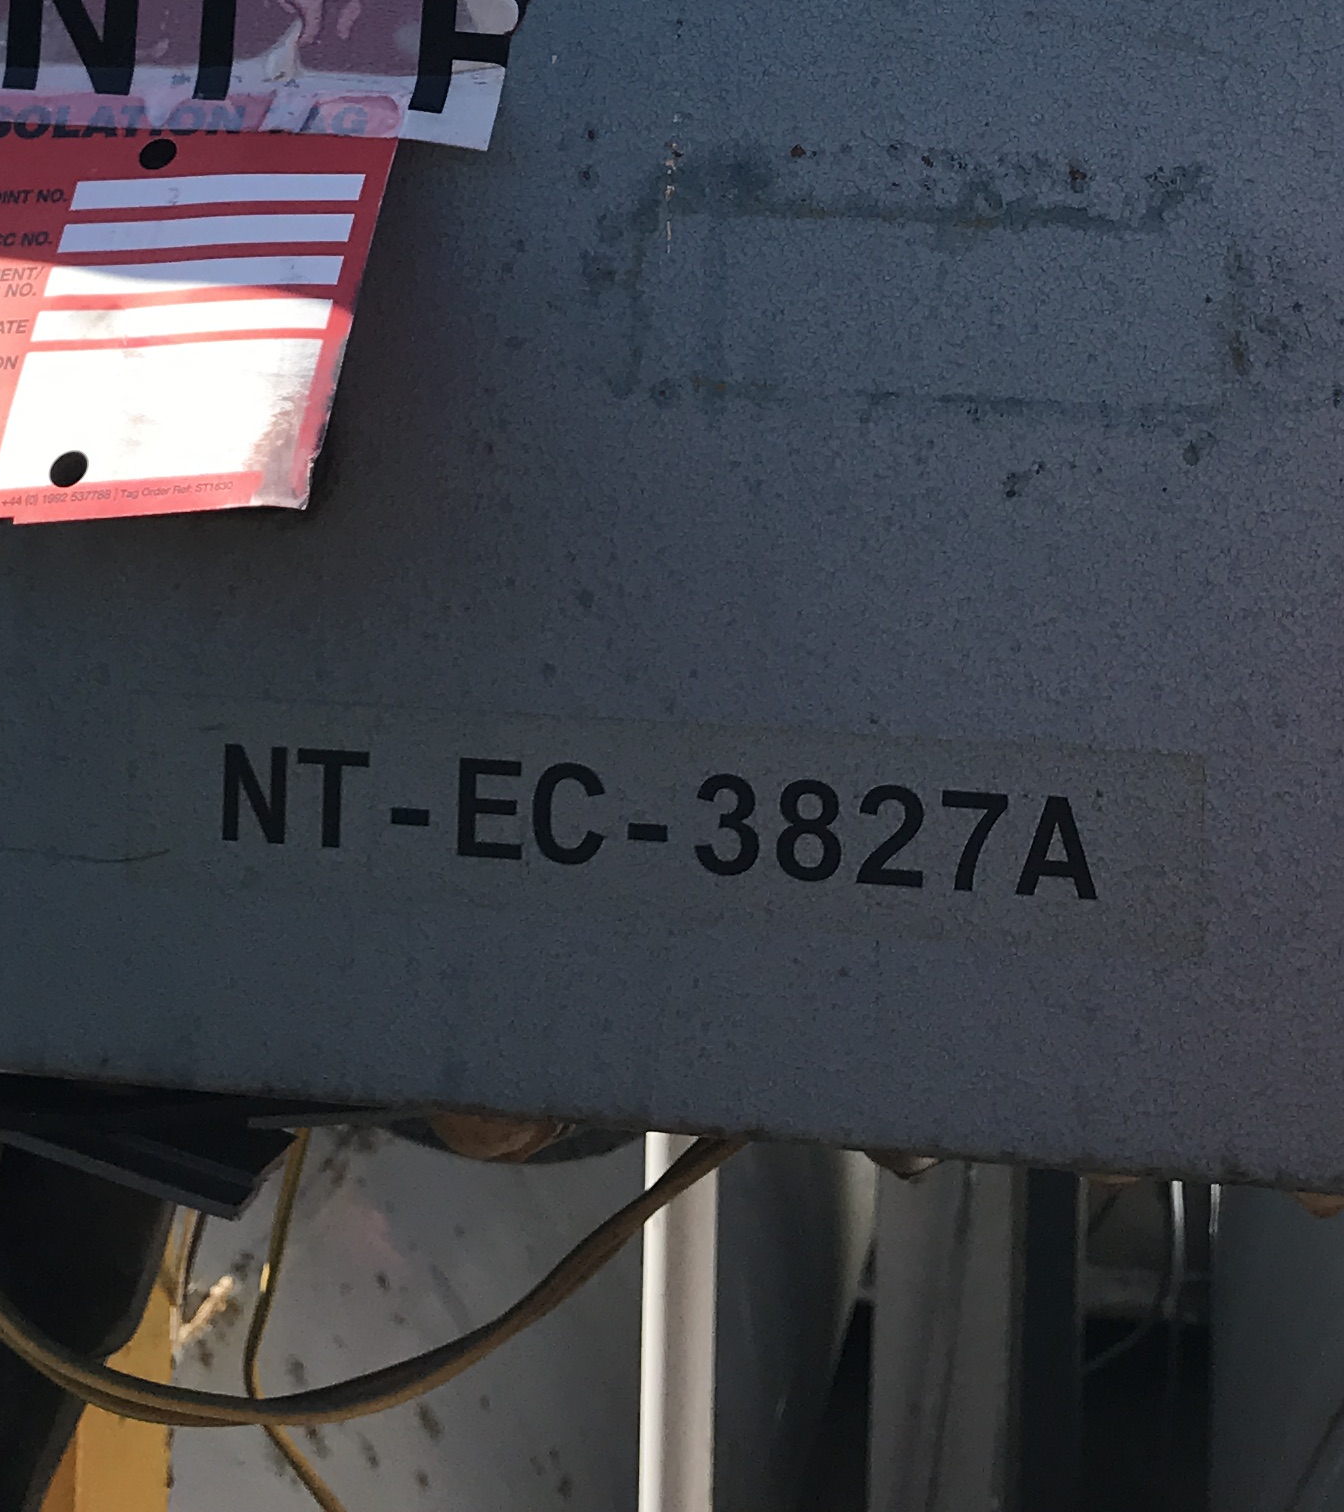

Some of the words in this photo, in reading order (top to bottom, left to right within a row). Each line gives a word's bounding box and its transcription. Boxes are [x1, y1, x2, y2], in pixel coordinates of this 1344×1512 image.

[35, 187, 68, 204] NO.
[20, 230, 53, 248] NO.
[8, 282, 38, 299] NO.
[220, 742, 1099, 902] NT-EC-3827A
